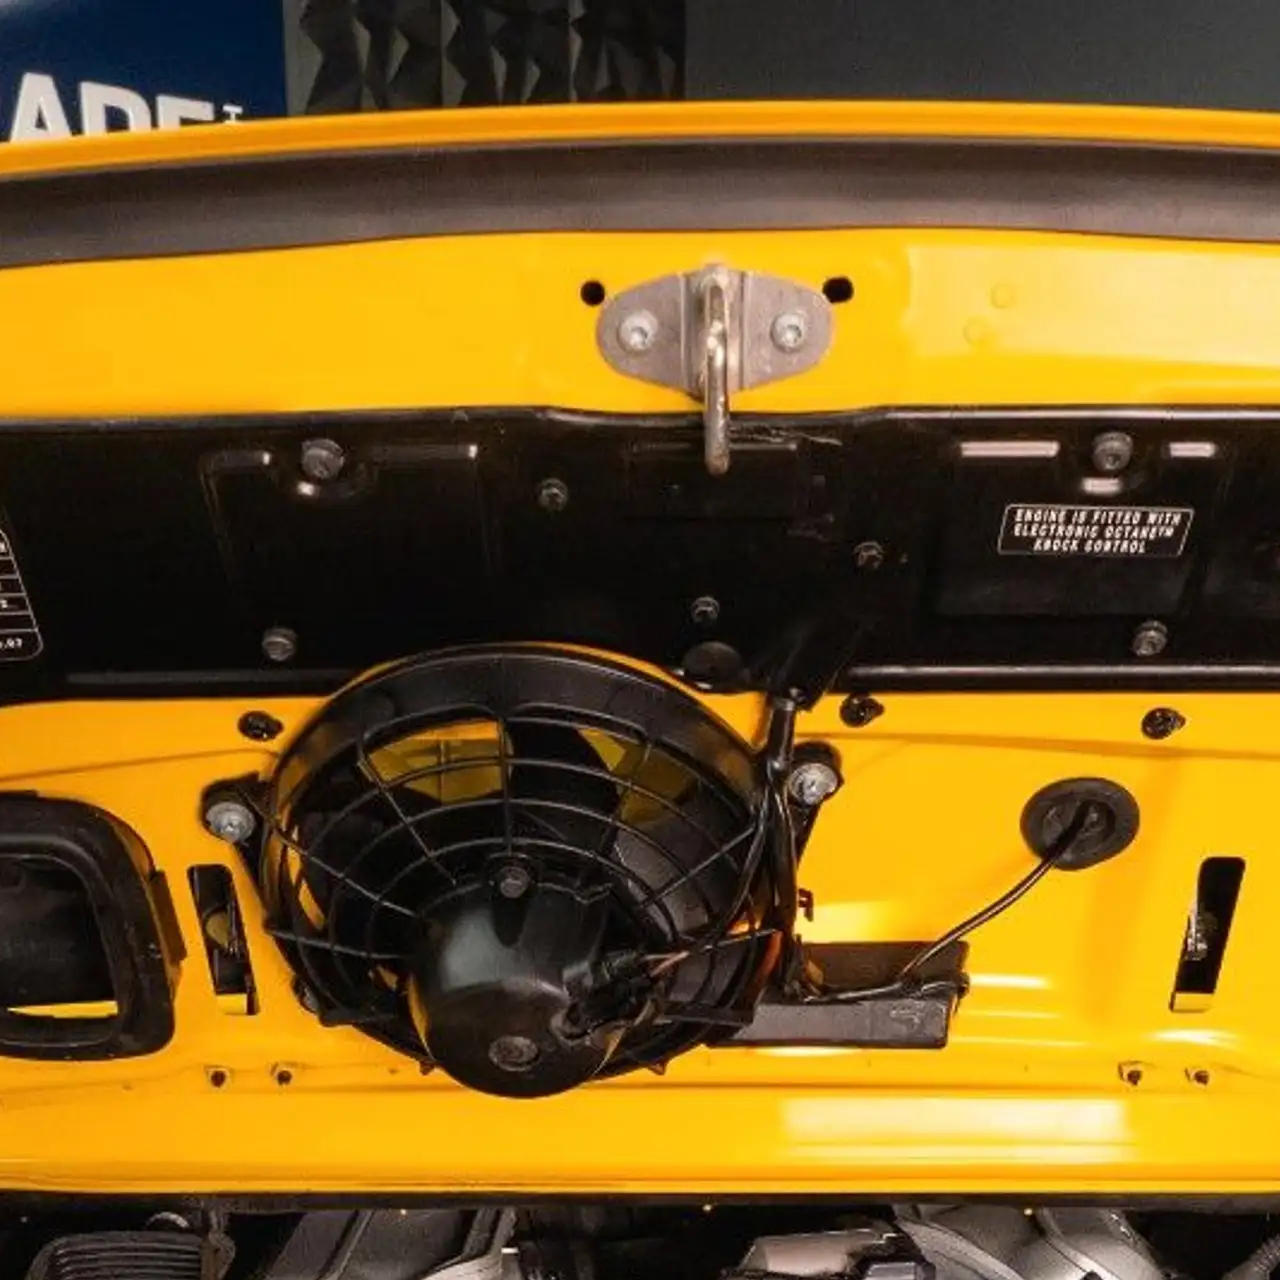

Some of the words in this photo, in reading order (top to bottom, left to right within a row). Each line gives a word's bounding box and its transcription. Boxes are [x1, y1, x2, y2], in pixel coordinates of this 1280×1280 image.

[1015, 508, 1067, 523] ENGINE
[1072, 509, 1087, 524] IS
[1091, 510, 1141, 524] FITTED
[1147, 511, 1181, 526] WITH
[1014, 522, 1099, 538] ELECTRONIC
[1033, 538, 1079, 551] KNOCK
[1084, 539, 1146, 554] CONTROL
